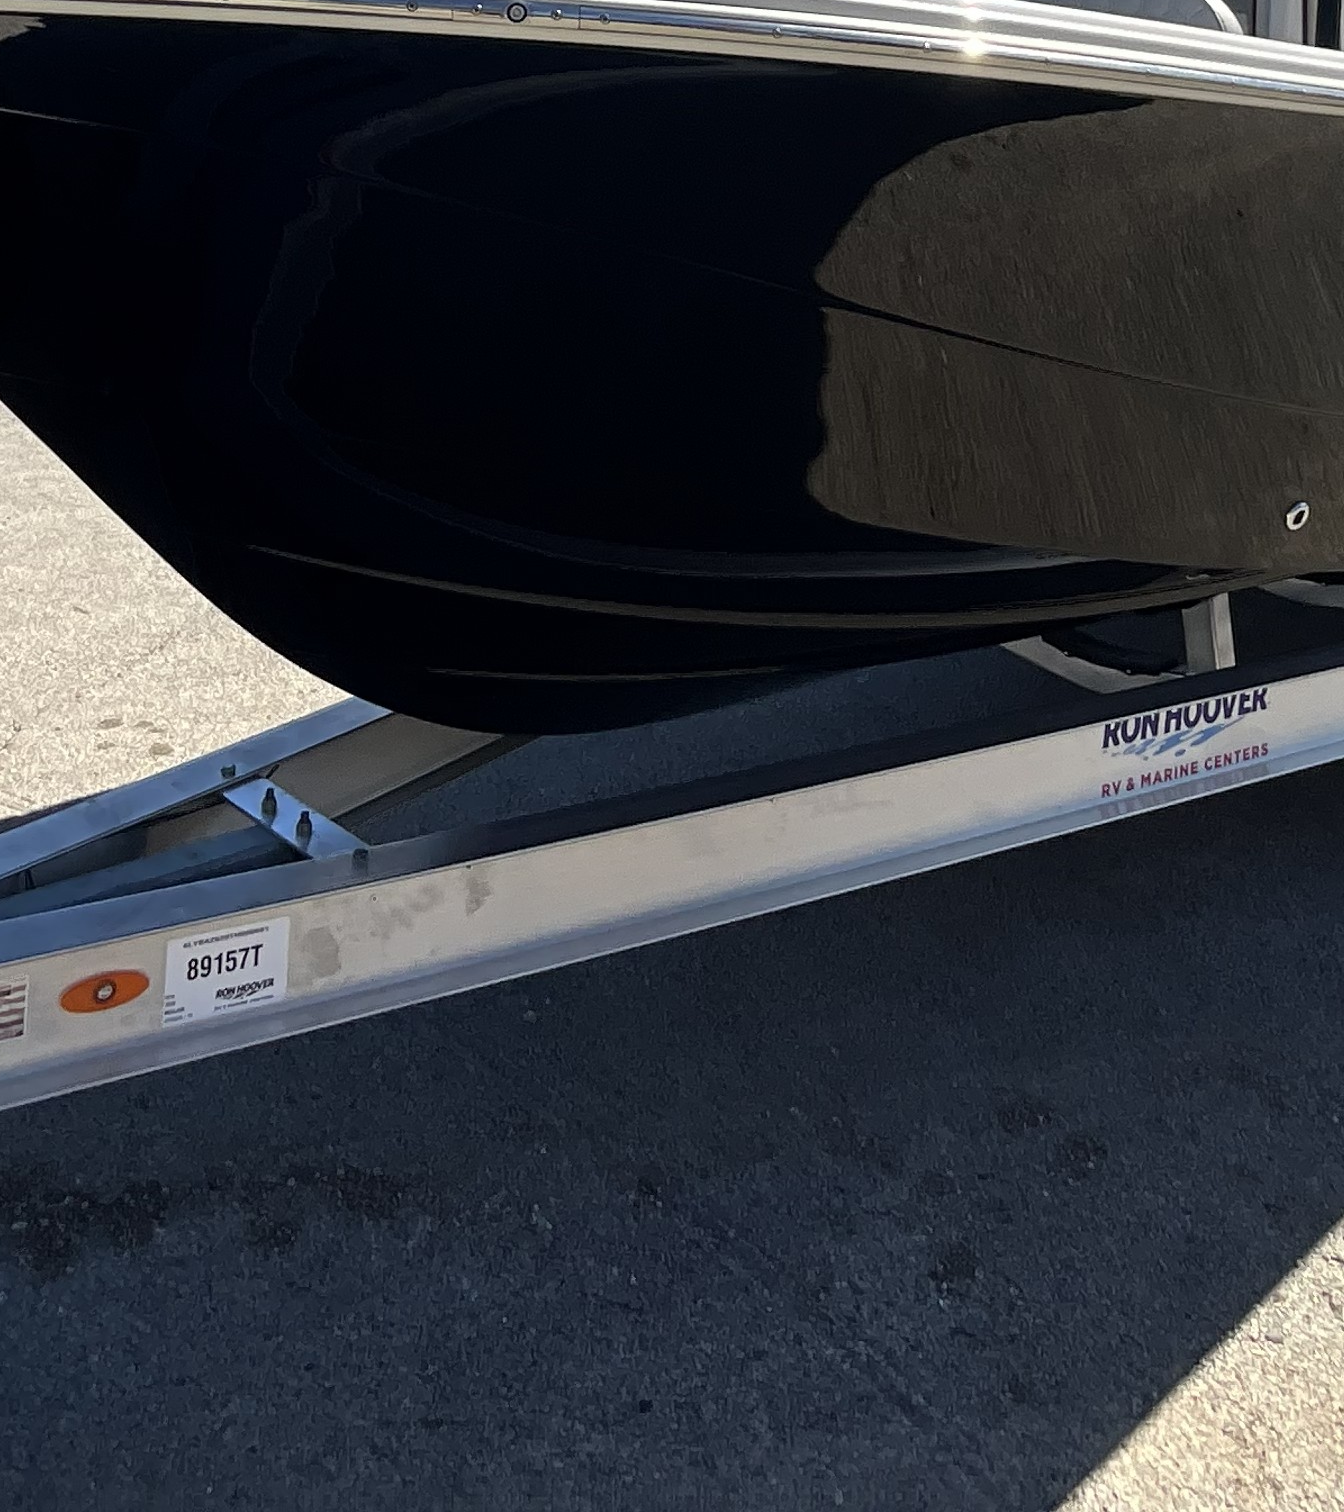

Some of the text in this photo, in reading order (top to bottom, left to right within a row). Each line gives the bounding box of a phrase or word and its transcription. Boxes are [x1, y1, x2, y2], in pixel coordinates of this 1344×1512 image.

[1101, 687, 1269, 749] RON HOOVER
[1101, 743, 1269, 798] RV & MARINE CENTERS
[186, 943, 264, 981] 89157T
